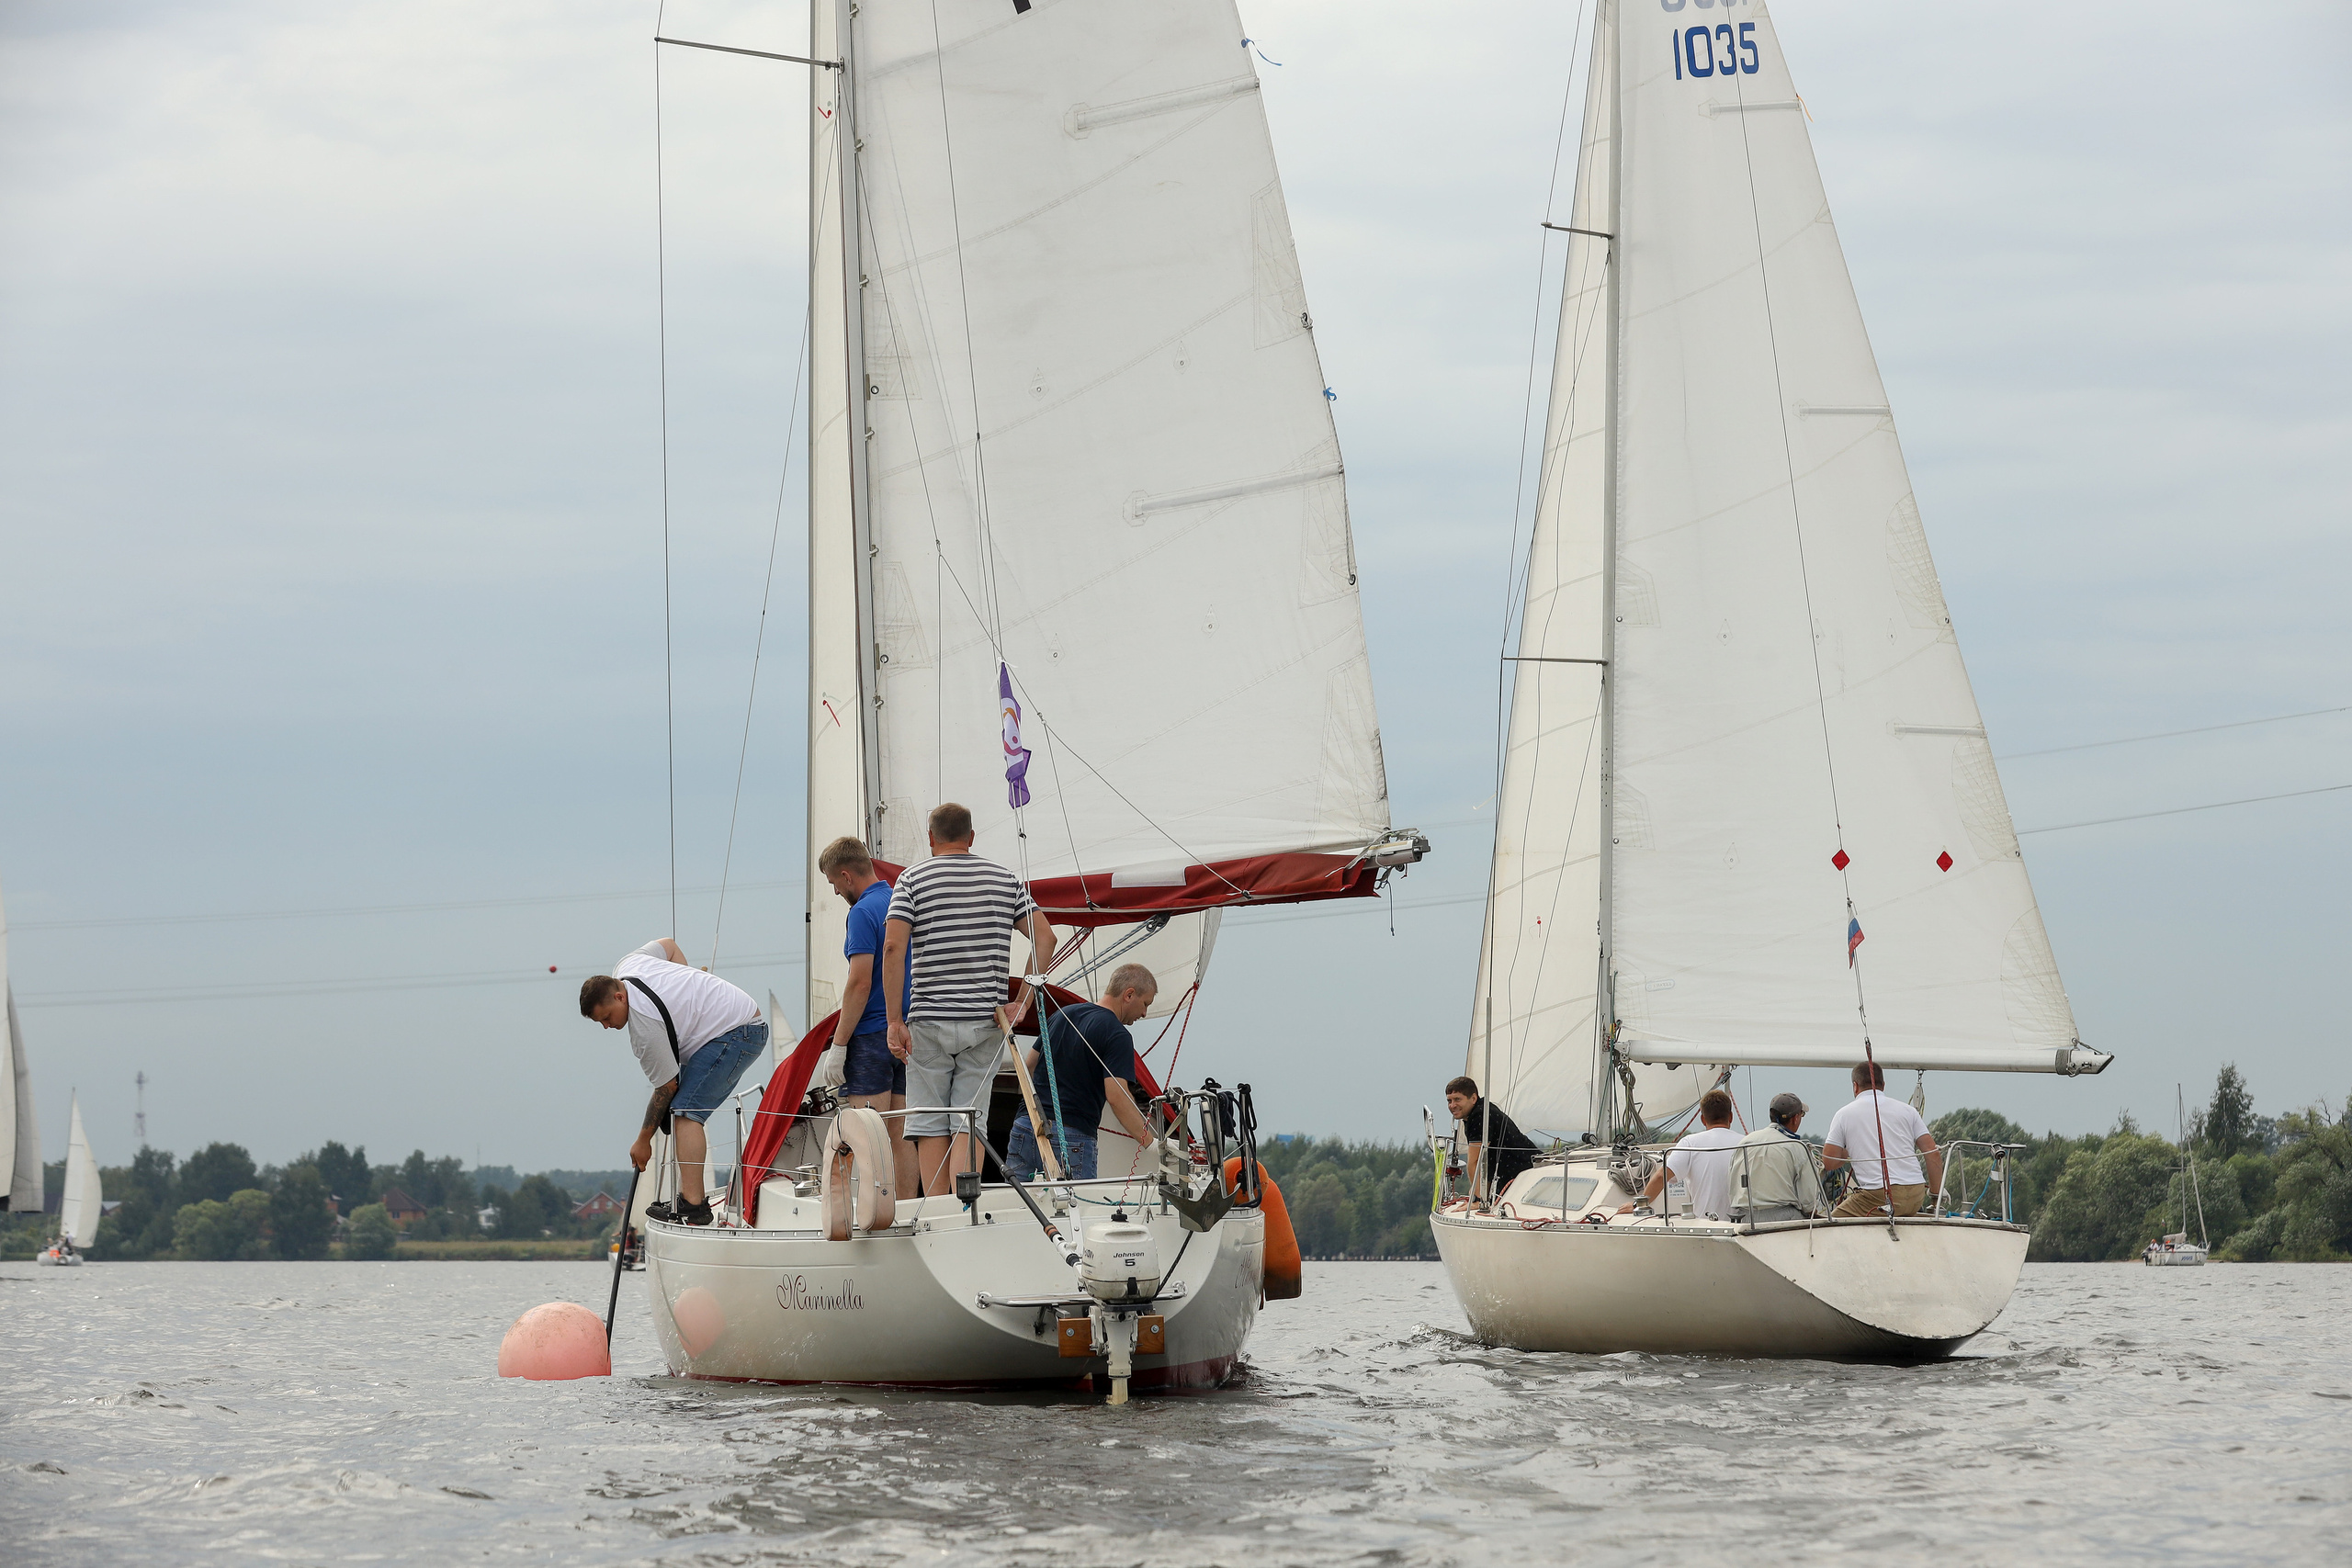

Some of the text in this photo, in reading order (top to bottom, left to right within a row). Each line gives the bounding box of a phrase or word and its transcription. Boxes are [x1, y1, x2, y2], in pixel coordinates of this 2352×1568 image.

[1673, 22, 1759, 80] 1035
[1125, 1258, 1136, 1267] 5
[776, 1274, 865, 1310] Marinella
